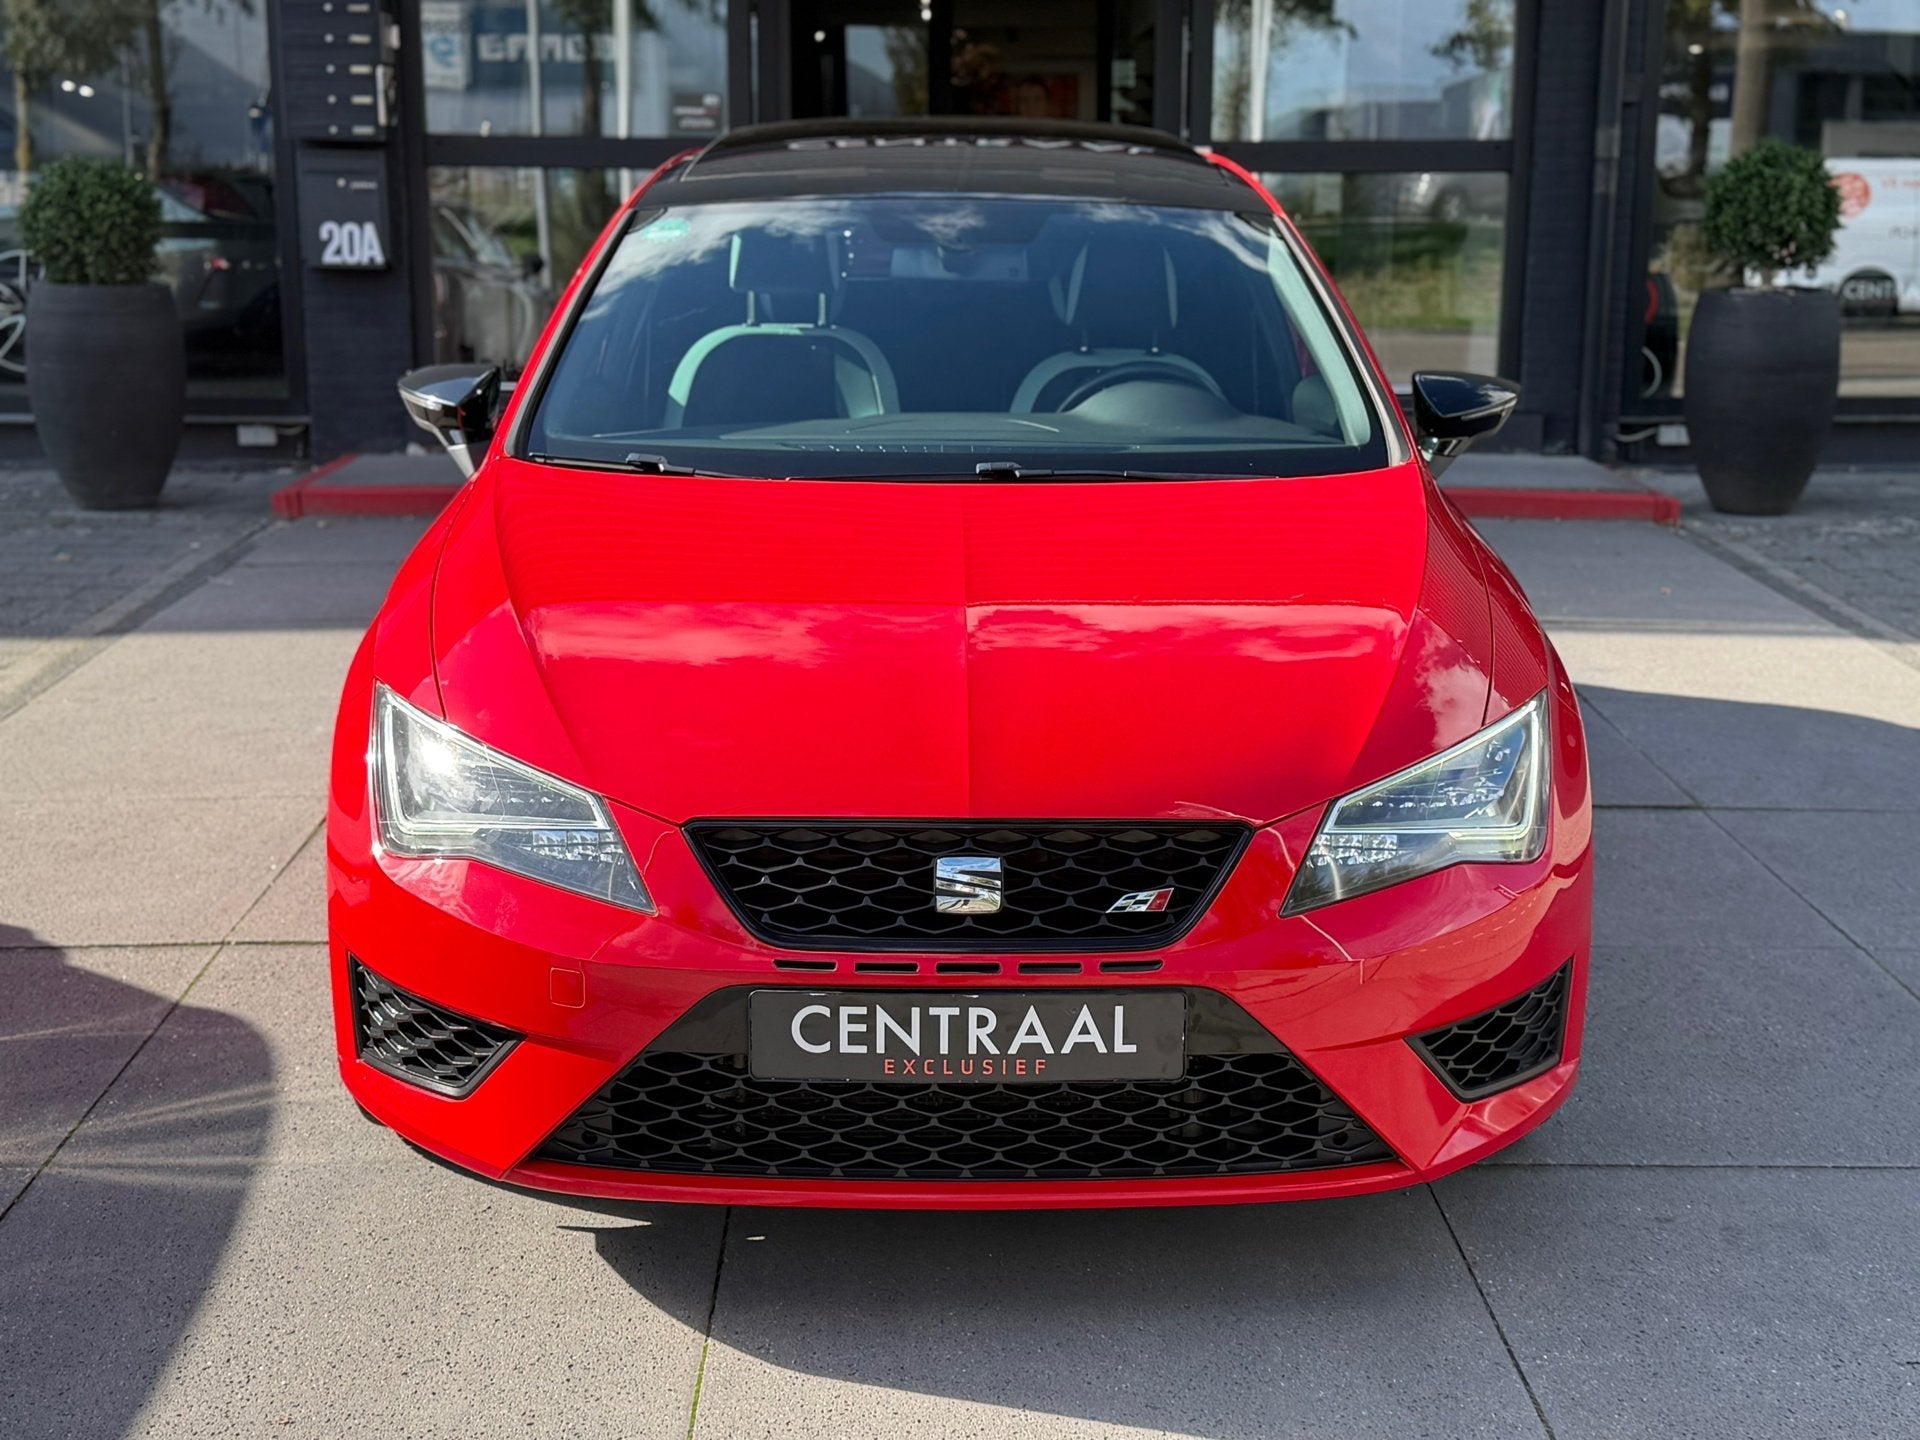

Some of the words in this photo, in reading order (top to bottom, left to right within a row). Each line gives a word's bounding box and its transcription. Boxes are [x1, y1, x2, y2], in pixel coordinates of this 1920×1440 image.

[319, 220, 385, 265] 20A
[791, 1004, 1137, 1056] CENTRAAL
[883, 1058, 1047, 1075] EXCLUSIEF
